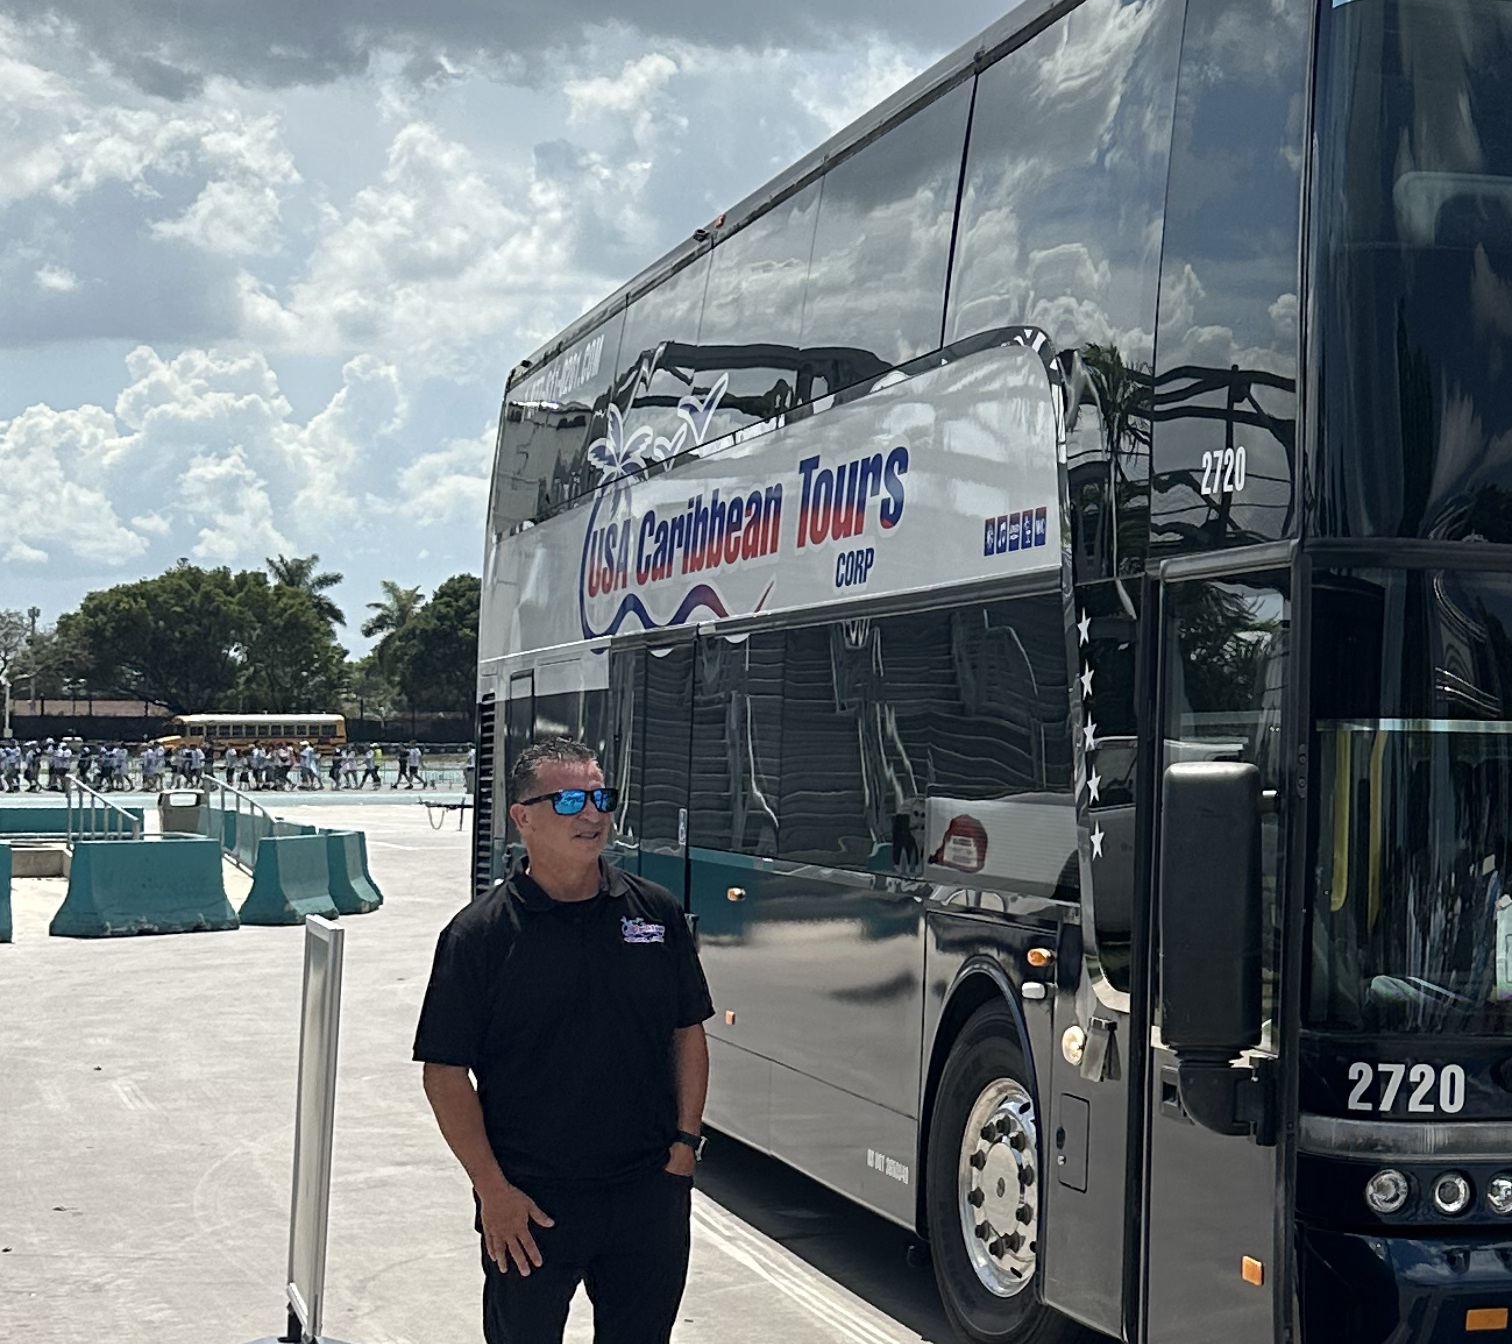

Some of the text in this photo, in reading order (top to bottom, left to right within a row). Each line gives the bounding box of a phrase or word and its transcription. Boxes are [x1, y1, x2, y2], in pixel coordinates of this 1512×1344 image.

[1201, 446, 1246, 495] 2720
[587, 446, 909, 598] USA Caribbean Tours
[835, 547, 875, 588] CORP
[1347, 1061, 1466, 1114] 2720
